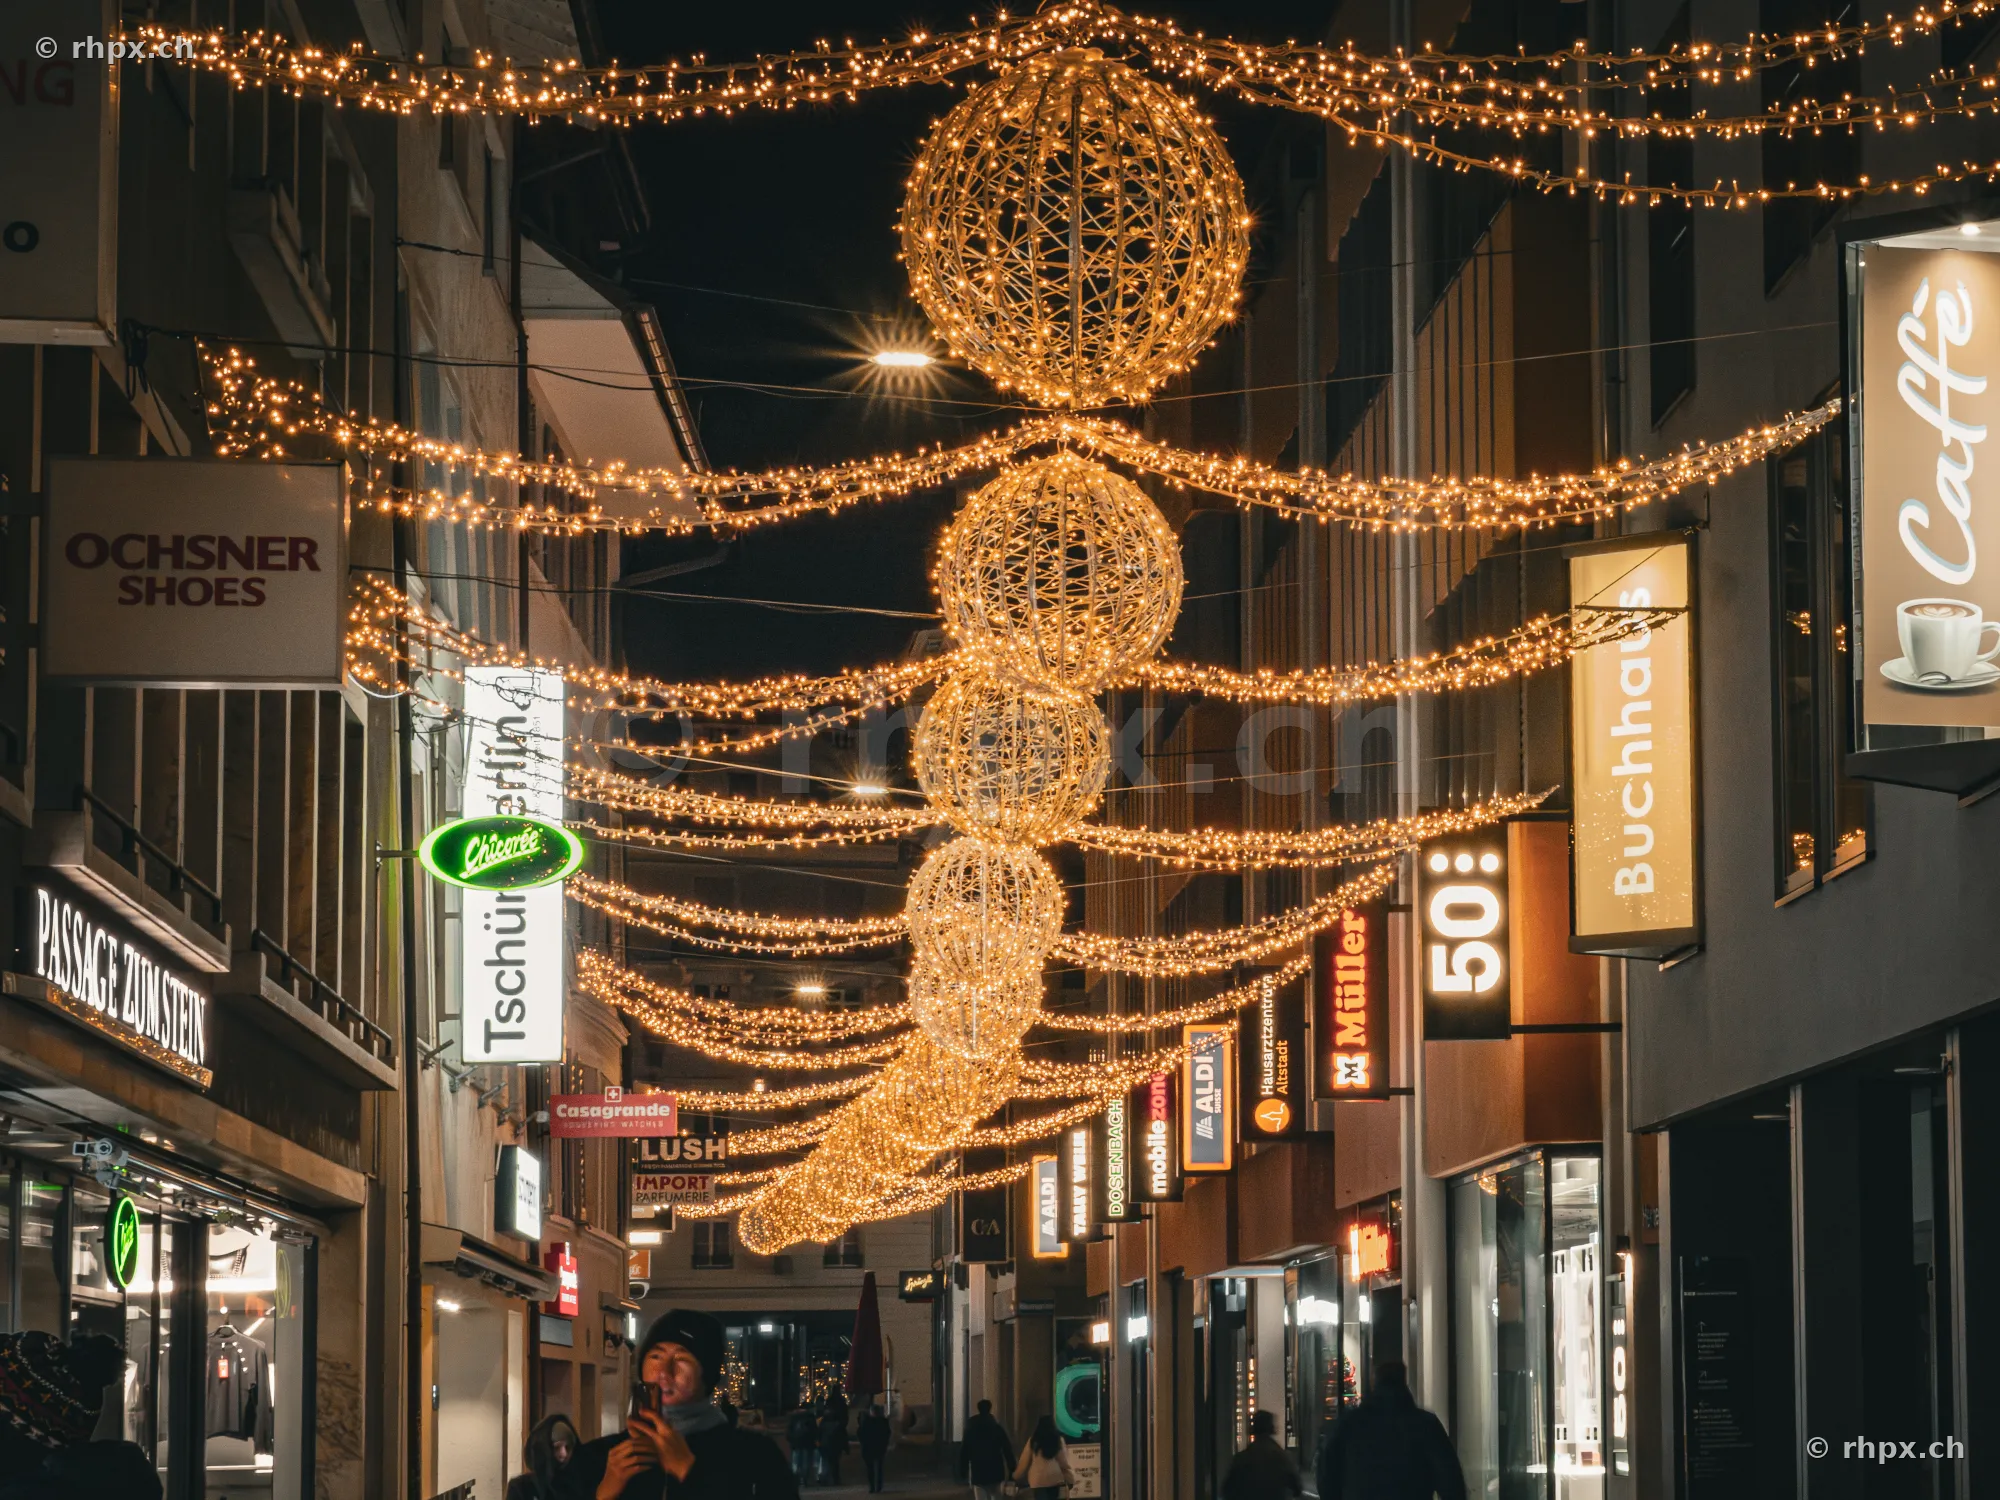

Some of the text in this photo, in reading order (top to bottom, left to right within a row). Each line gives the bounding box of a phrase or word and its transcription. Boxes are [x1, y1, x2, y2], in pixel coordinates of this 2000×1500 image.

[65, 532, 322, 572] OCHSNER
[117, 575, 267, 607] SHOES
[1610, 586, 1655, 897] Buchhaus
[464, 827, 541, 873] Chicorée
[37, 888, 206, 1065] PASSAGE ZUM STEIN
[1335, 910, 1367, 1047] Müller
[1195, 1056, 1214, 1114] ALDI
[1276, 1040, 1289, 1095] Altstadt
[556, 1103, 671, 1119] Casagrande
[1214, 1088, 1222, 1114] SUISSE
[641, 1138, 727, 1161] LUSH
[1108, 1098, 1124, 1217] DOSENBACH
[635, 1191, 710, 1203] PARFUMERIE
[636, 1175, 710, 1191] IMPORT
[1041, 1177, 1056, 1218] ALDI
